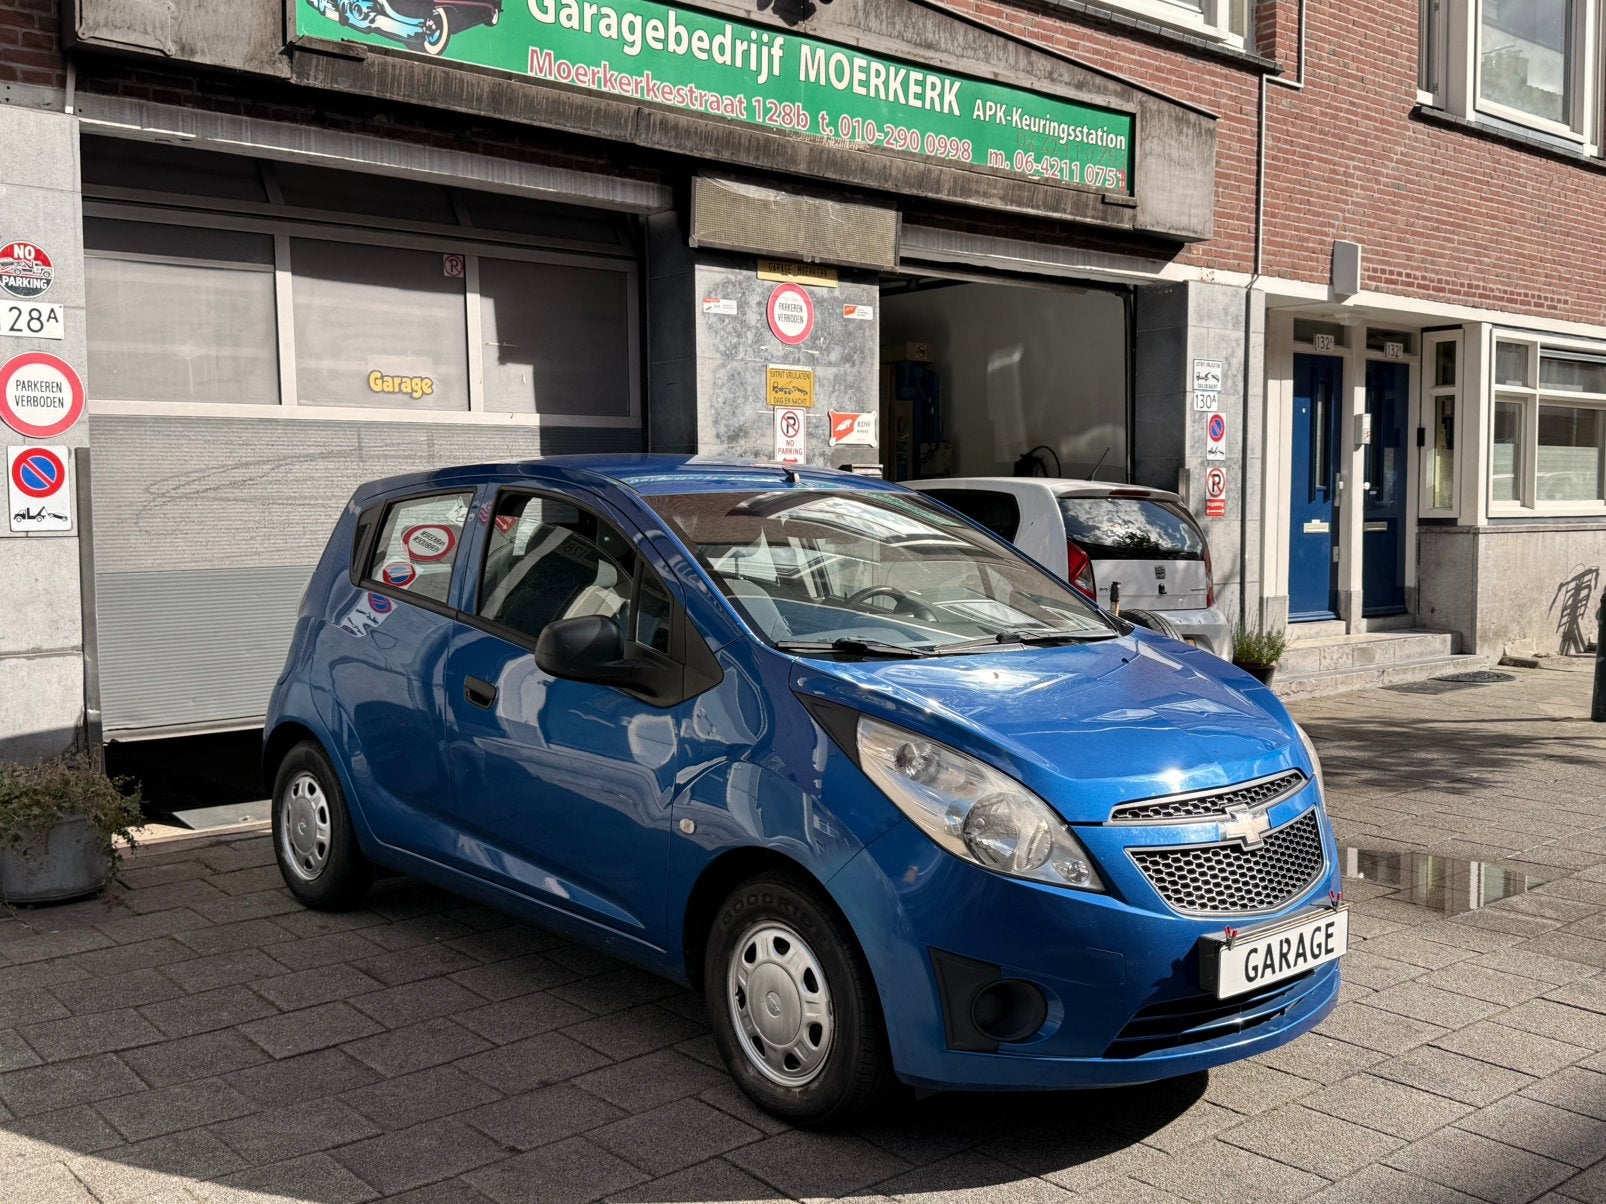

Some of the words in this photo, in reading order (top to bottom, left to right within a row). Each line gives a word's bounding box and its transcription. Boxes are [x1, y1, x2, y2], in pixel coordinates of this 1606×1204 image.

[527, 0, 785, 85] Garagebedrijf
[799, 43, 962, 117] MOERKERK
[972, 98, 1126, 150] APK-Keuringsstation
[528, 46, 747, 119] Moerkerkestraat
[752, 96, 810, 130] 128b
[818, 110, 835, 136] t.
[838, 113, 921, 152] 010-290
[924, 131, 973, 161] 0998
[988, 148, 1011, 170] m.
[1013, 149, 1080, 184] 06-4211
[13, 244, 36, 260] NO
[2, 275, 48, 289] PARKING
[778, 302, 803, 313] PARKEREN
[777, 313, 804, 325] VERBODEN
[15, 379, 63, 393] PARKEREN
[368, 369, 434, 400] Garage
[14, 394, 65, 409] VERBODEN
[786, 440, 795, 448] NO
[777, 447, 803, 456] PARKING
[1244, 921, 1336, 983] GARAGE
